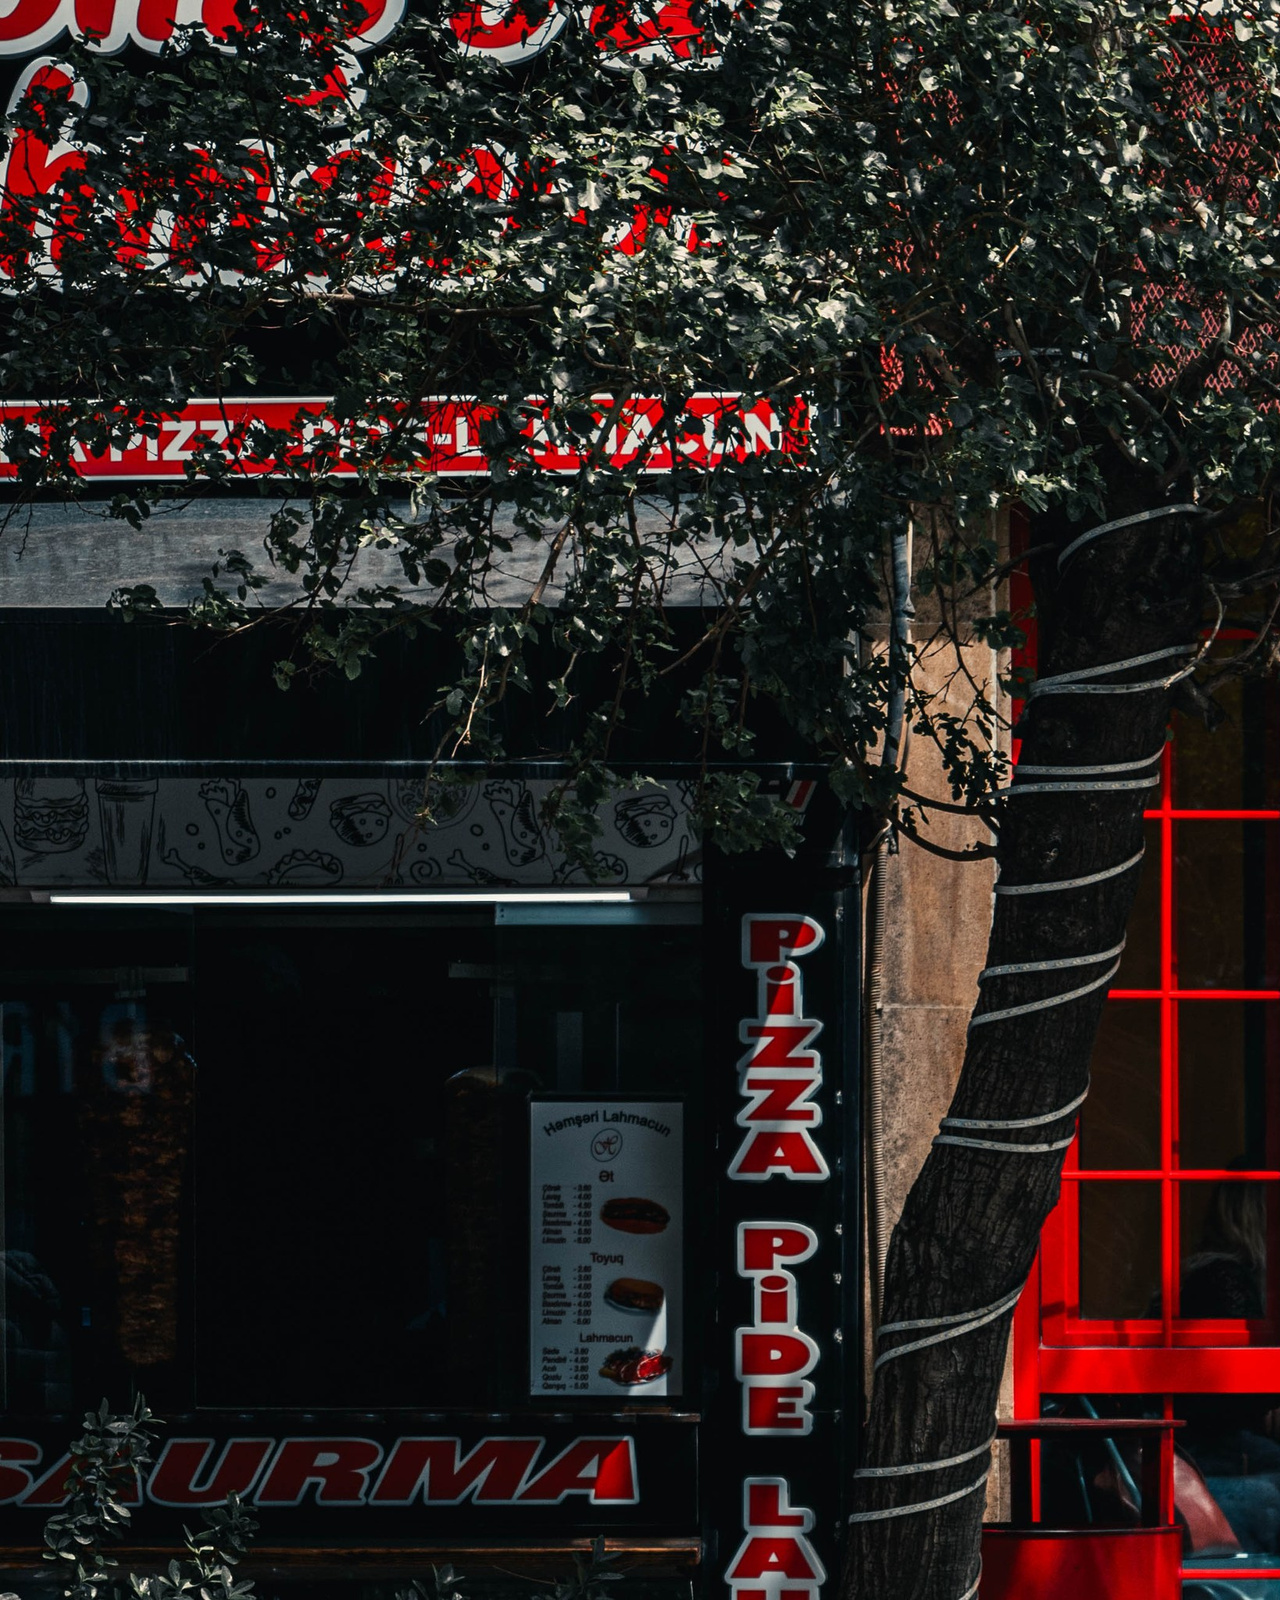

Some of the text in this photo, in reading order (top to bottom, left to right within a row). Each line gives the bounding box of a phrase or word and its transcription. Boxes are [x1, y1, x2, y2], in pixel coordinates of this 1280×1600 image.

[603, 1109, 672, 1137] Lahmacun
[590, 1252, 625, 1266] Toyuq
[579, 1332, 634, 1343] Lahmacun
